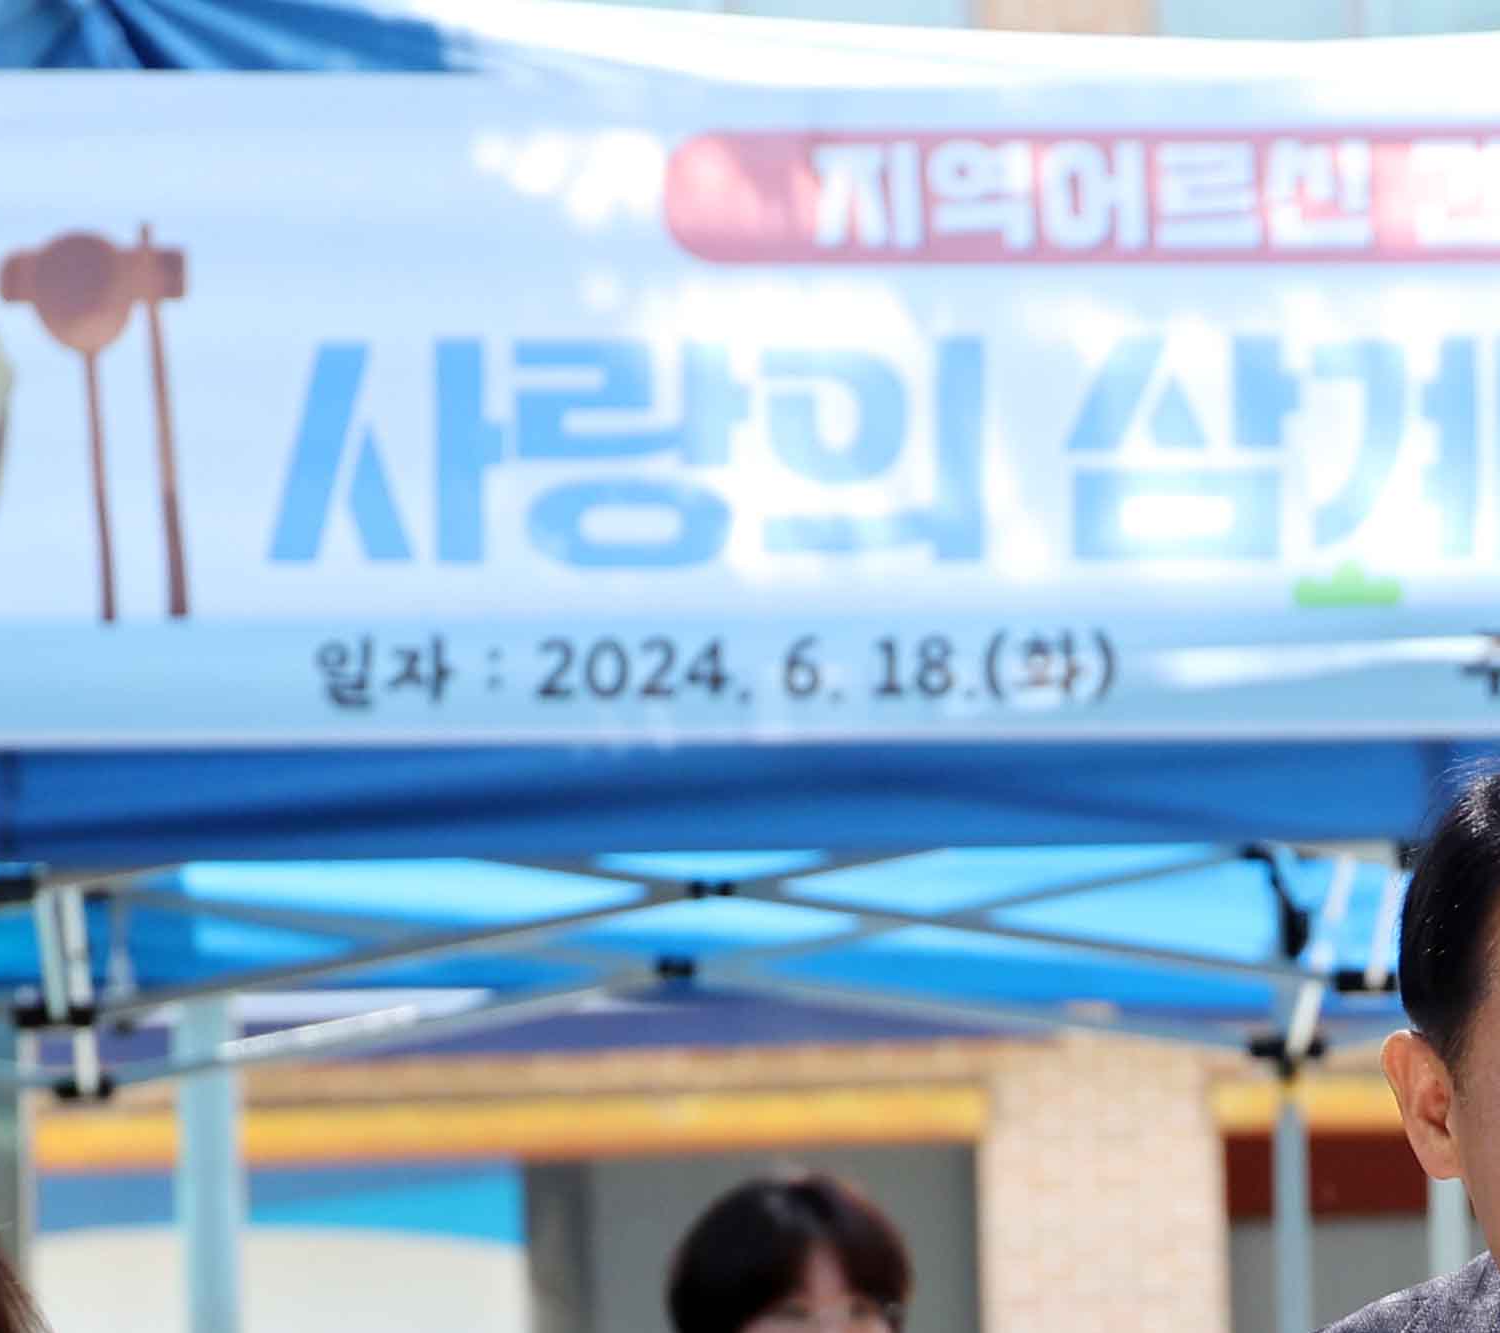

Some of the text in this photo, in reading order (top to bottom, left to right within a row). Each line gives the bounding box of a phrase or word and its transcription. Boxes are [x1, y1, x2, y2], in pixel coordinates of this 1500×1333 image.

[810, 136, 1376, 252] 지역어르신
[264, 332, 990, 572] 사랑의
[315, 634, 455, 710] 일자
[534, 634, 752, 704] 2024.
